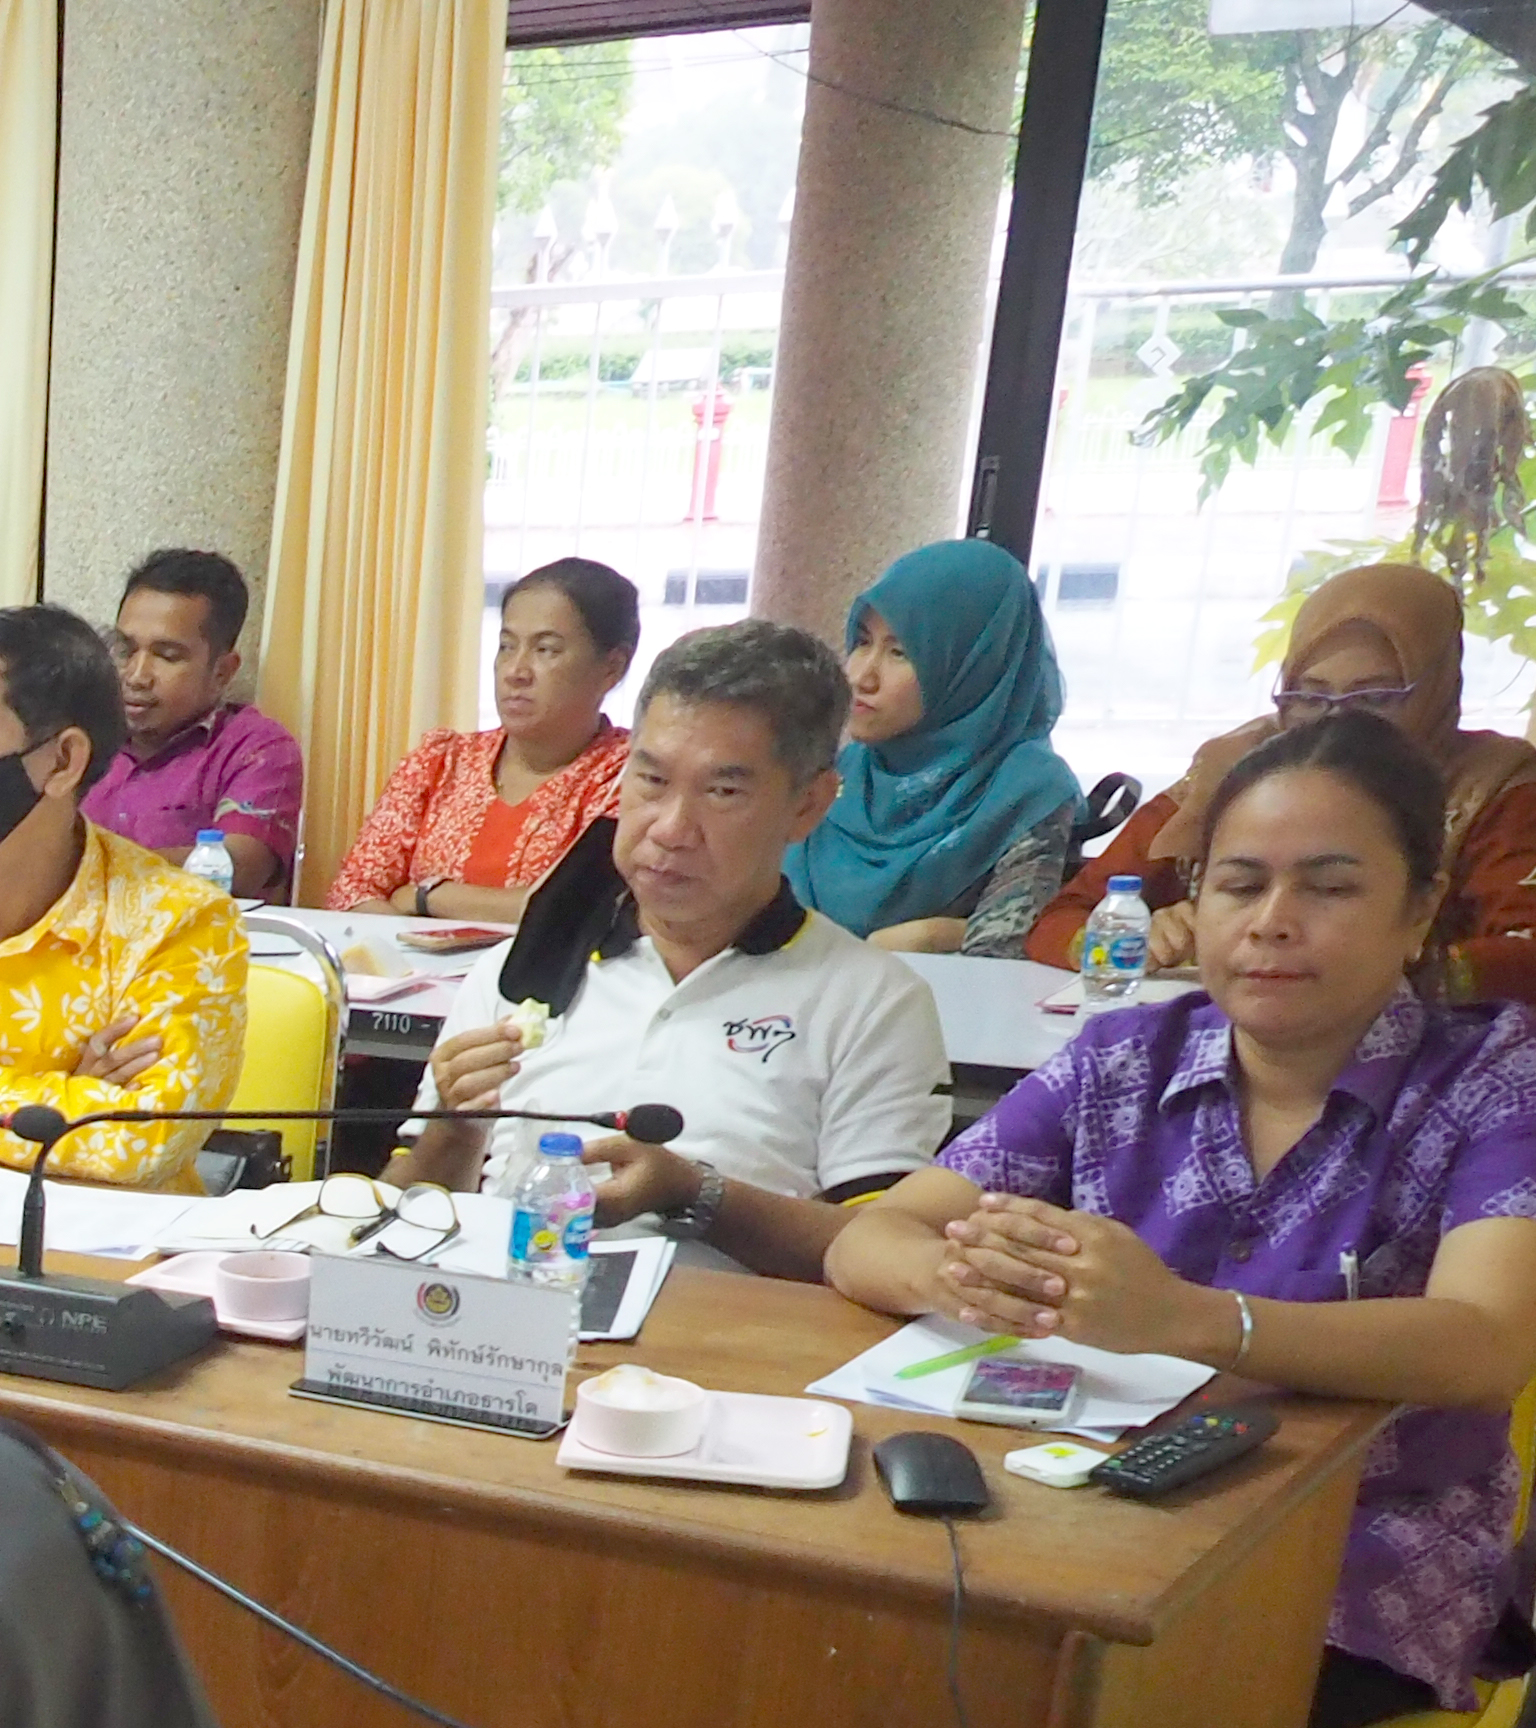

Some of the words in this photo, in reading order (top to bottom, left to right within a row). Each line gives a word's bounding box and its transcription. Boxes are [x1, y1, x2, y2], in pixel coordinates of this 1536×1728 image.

[61, 1309, 109, 1329] NPE
[309, 1324, 414, 1353] นายทวีวัฒน์
